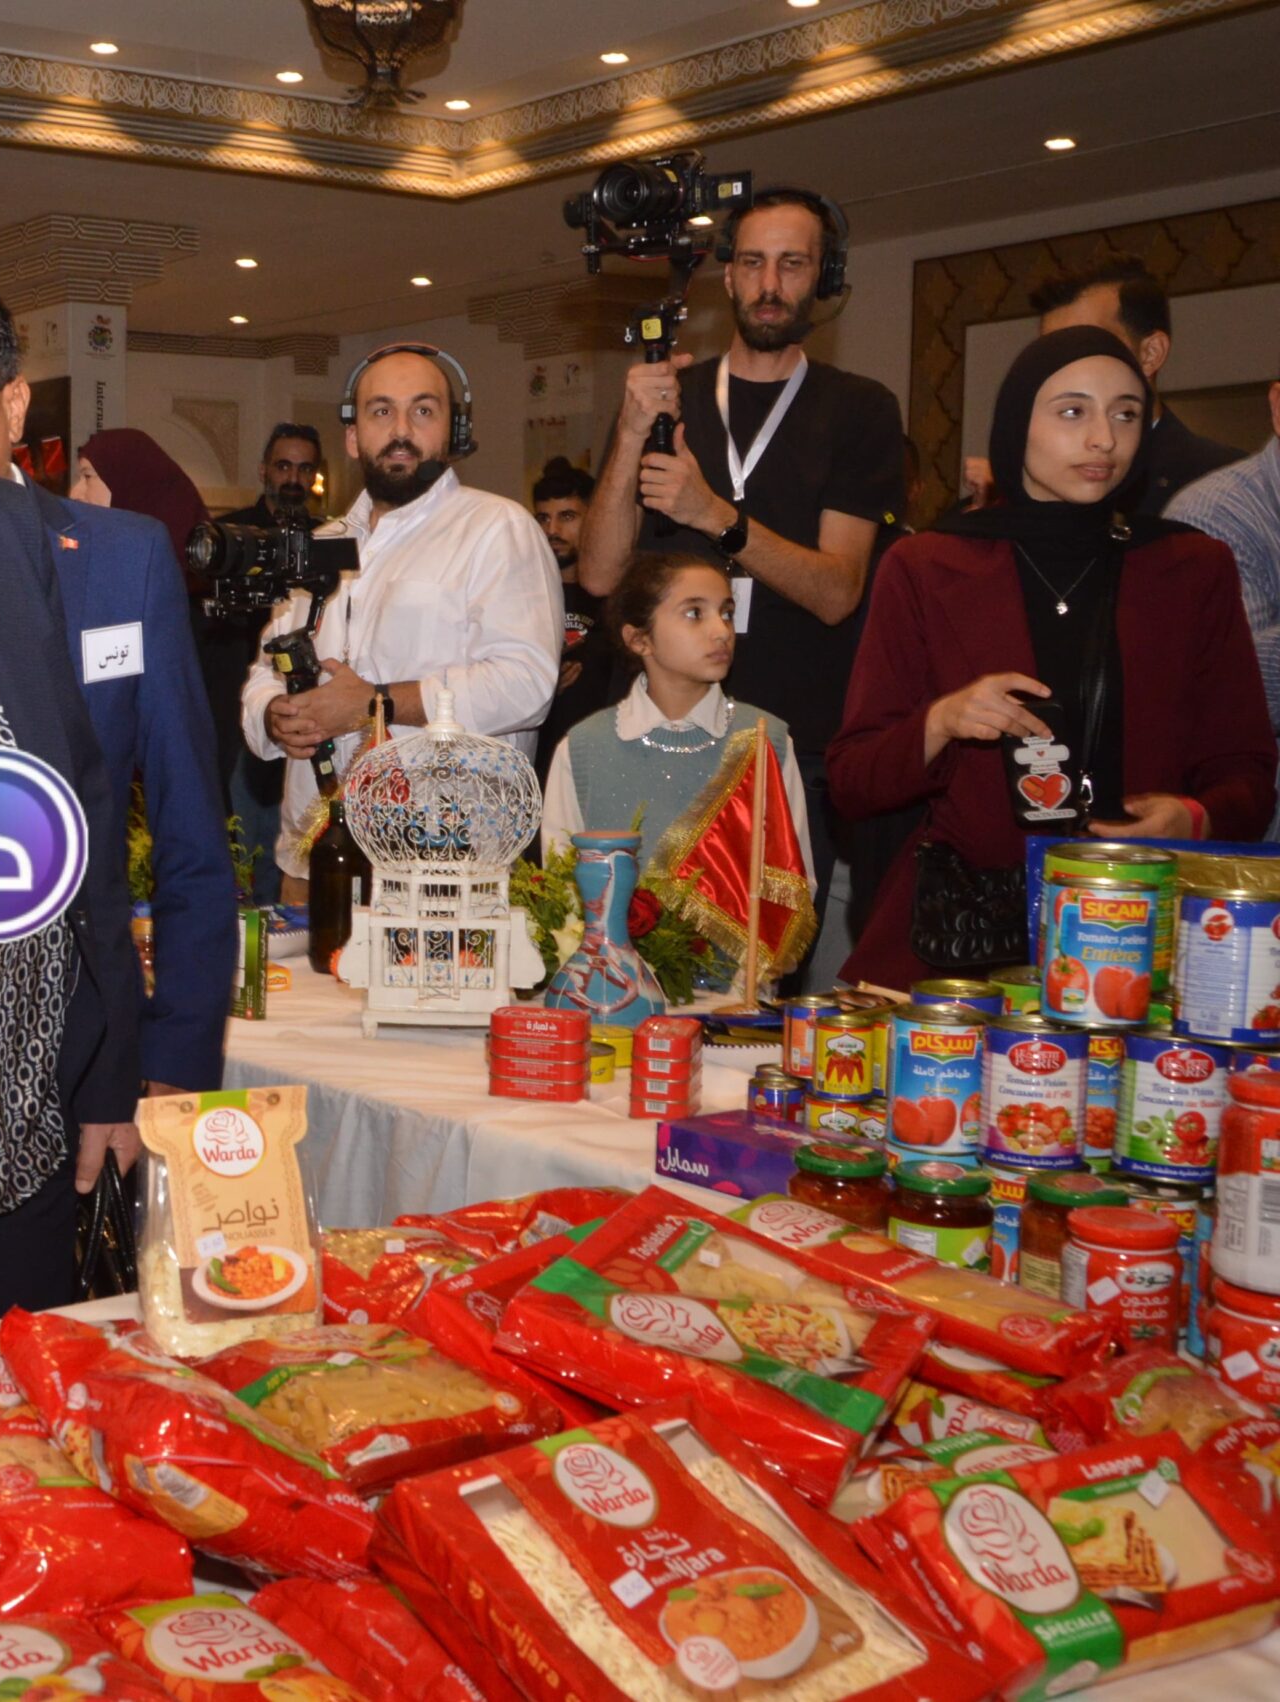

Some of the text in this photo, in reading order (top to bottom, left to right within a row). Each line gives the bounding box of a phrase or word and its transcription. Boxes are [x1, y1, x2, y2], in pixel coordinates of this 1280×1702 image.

[96, 380, 107, 432] Interna
[98, 644, 130, 670] تونس
[1083, 901, 1147, 919] SICAM
[1077, 931, 1119, 945] Tomates
[912, 1034, 974, 1054] سيكام
[202, 1144, 259, 1164] Warda
[202, 1197, 280, 1233] نواصر
[1079, 1454, 1145, 1480] Lasagne
[581, 1485, 651, 1516] Warda
[664, 1547, 727, 1580] Njara
[979, 1556, 1071, 1594] Warda
[182, 1636, 298, 1673] Warda
